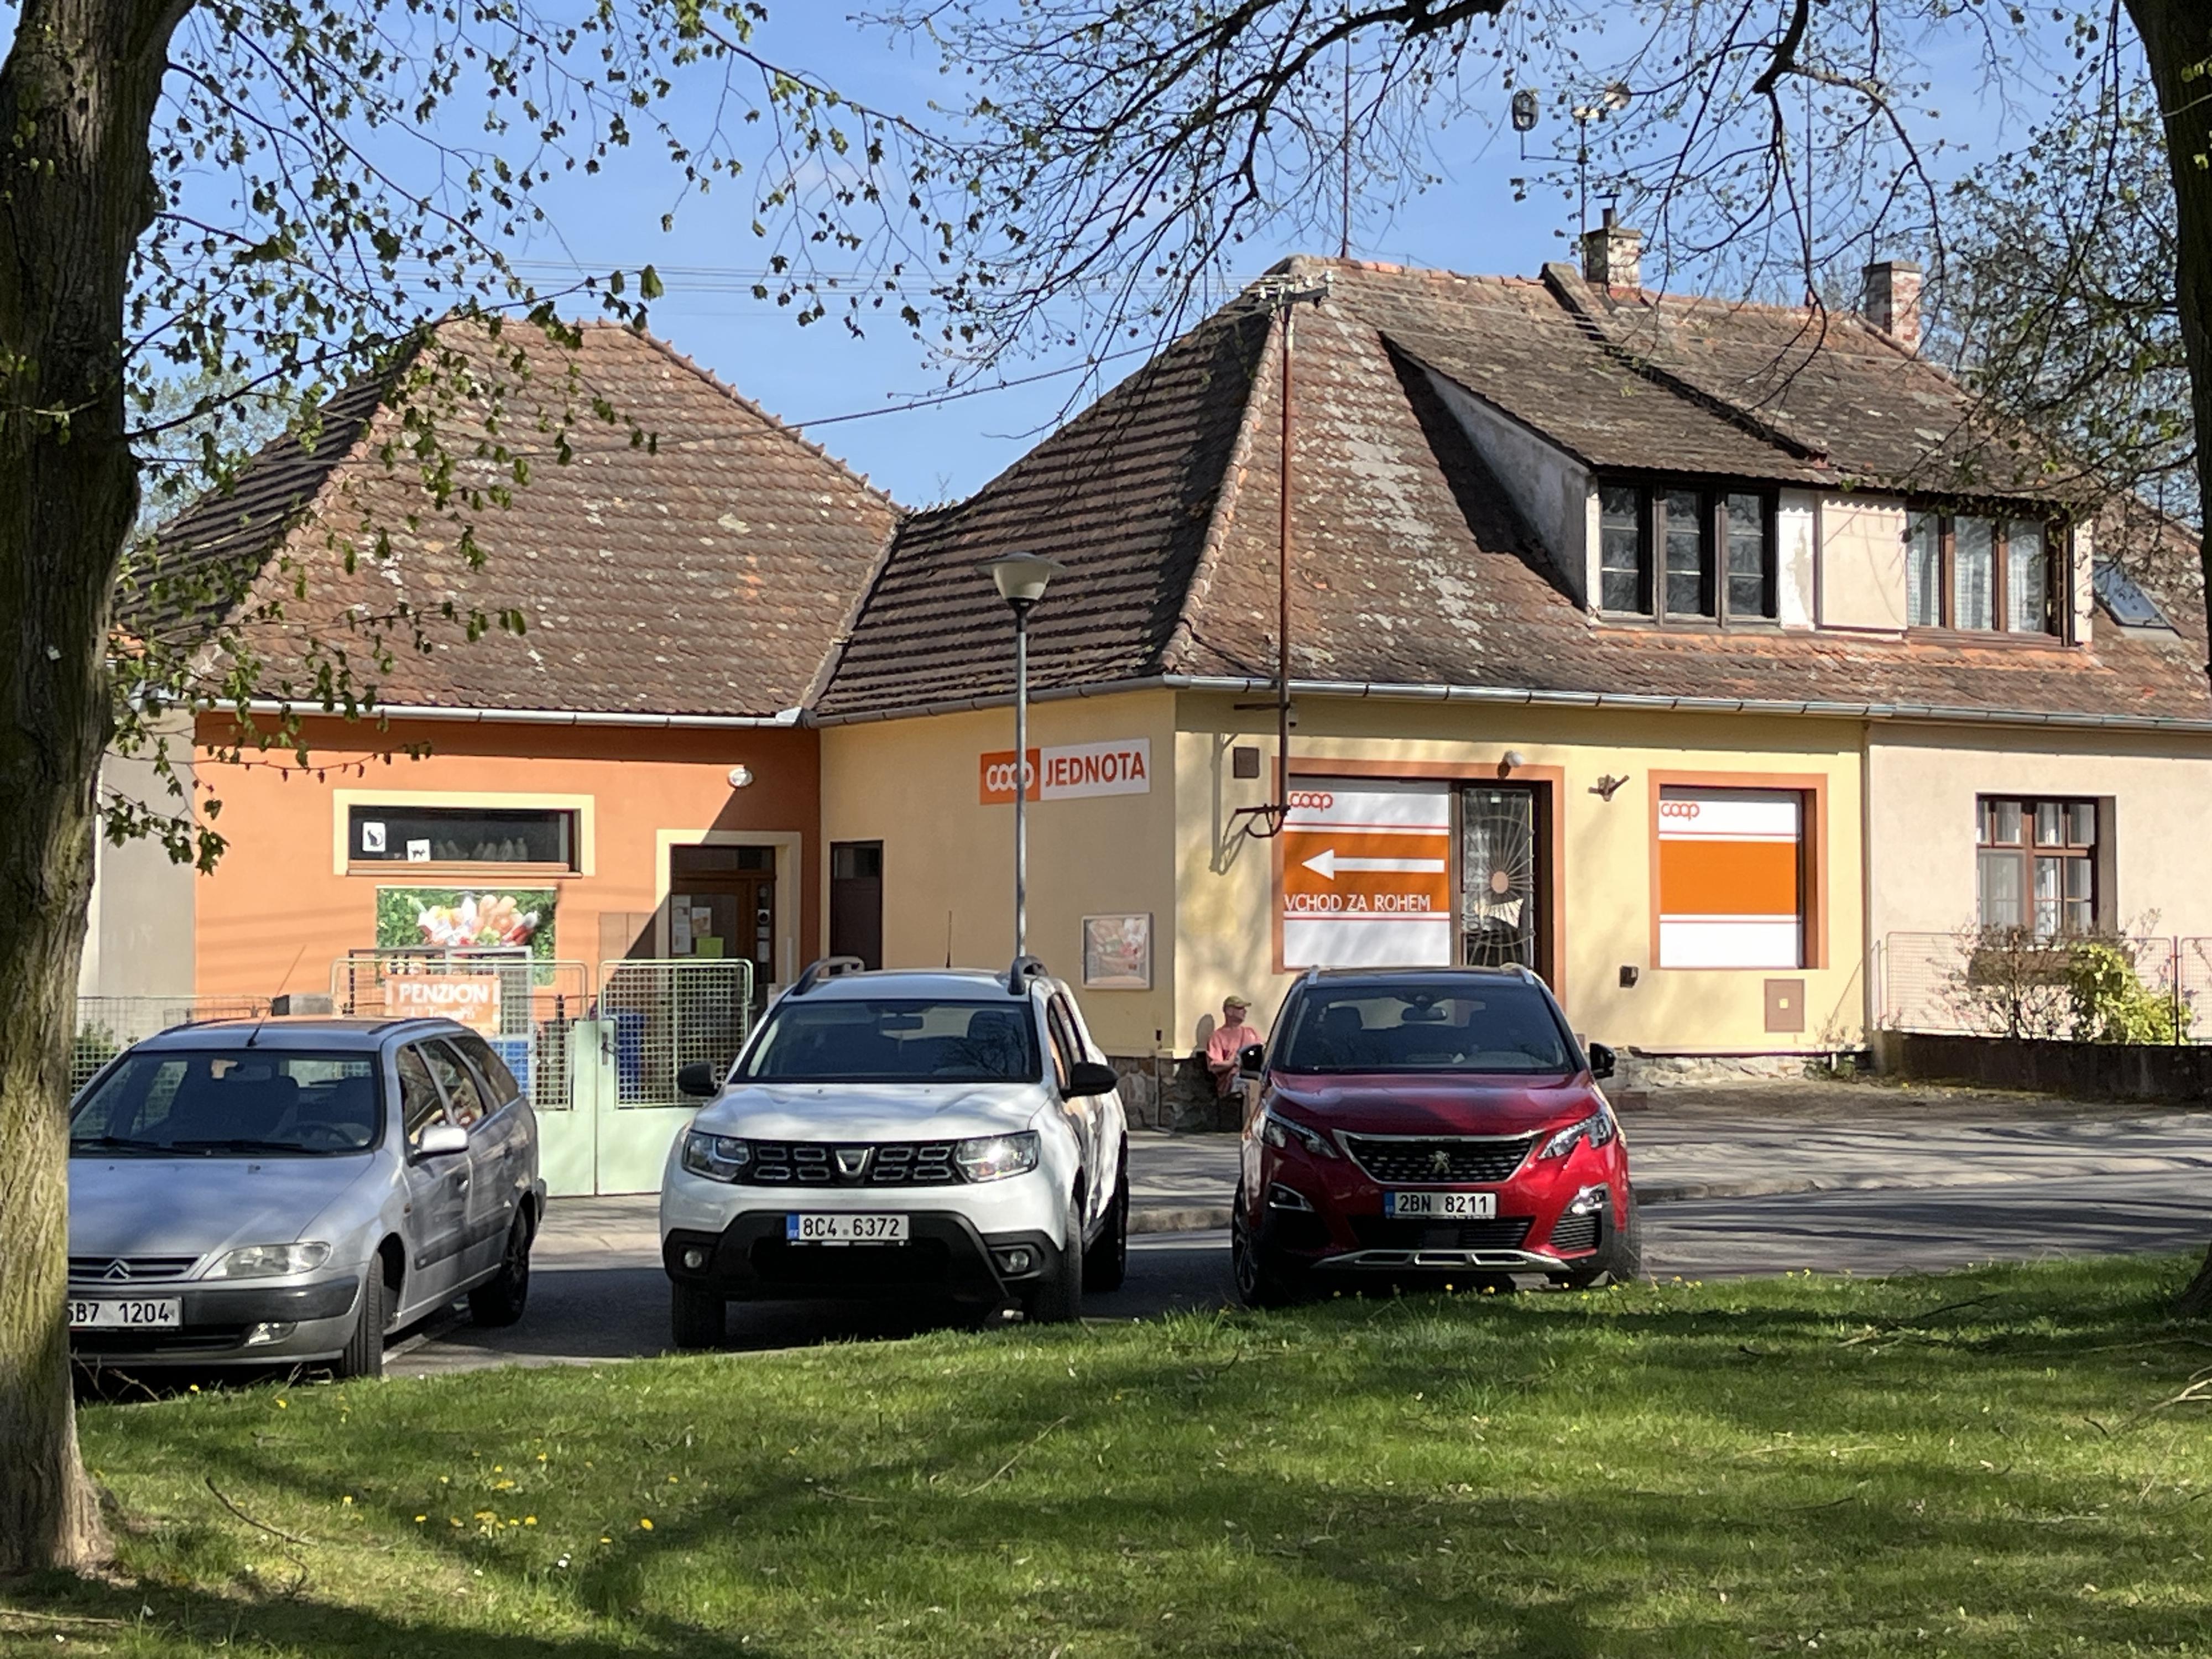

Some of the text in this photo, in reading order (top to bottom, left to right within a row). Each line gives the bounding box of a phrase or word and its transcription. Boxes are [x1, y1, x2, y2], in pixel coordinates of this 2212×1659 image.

[1046, 752, 1146, 787] JEDNOTA
[1290, 793, 1333, 812] coop
[1661, 803, 1699, 821] coop
[1284, 893, 1431, 911] VCHOD ZA ROHEM
[399, 983, 488, 1003] PENZION
[1399, 1194, 1486, 1213] 2BN 8211
[803, 1218, 837, 1237] 8C4
[853, 1218, 900, 1237] 6372
[118, 1302, 170, 1323] 1204
